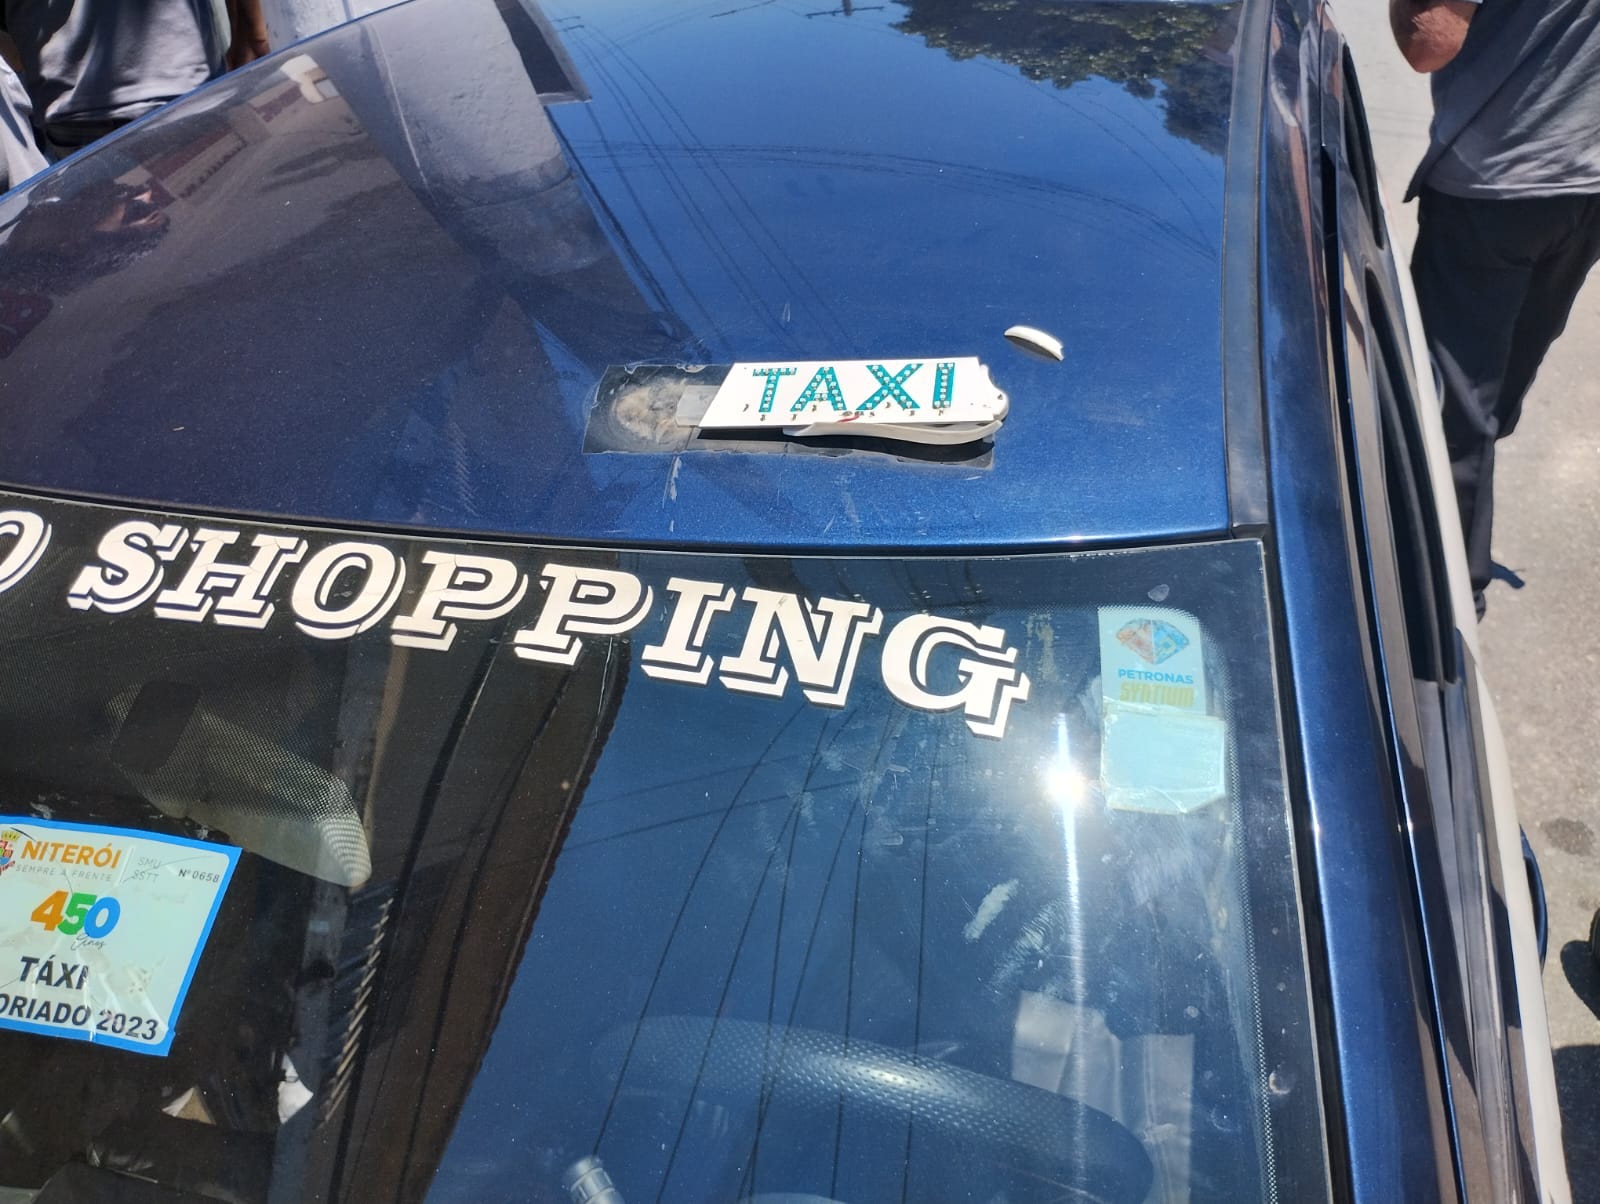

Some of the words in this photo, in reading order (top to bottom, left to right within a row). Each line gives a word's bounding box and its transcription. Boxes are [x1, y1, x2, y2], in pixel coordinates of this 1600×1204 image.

[752, 361, 956, 413] TAXI
[66, 520, 1031, 741] SHOPPING
[1117, 668, 1194, 685] PETRONAS
[20, 840, 122, 869] NITERÓI
[15, 863, 55, 876] SEMPRE
[71, 870, 113, 883] FRENTE
[191, 870, 220, 883] 0658
[30, 889, 121, 939] 450
[96, 1009, 159, 1040] 2023
